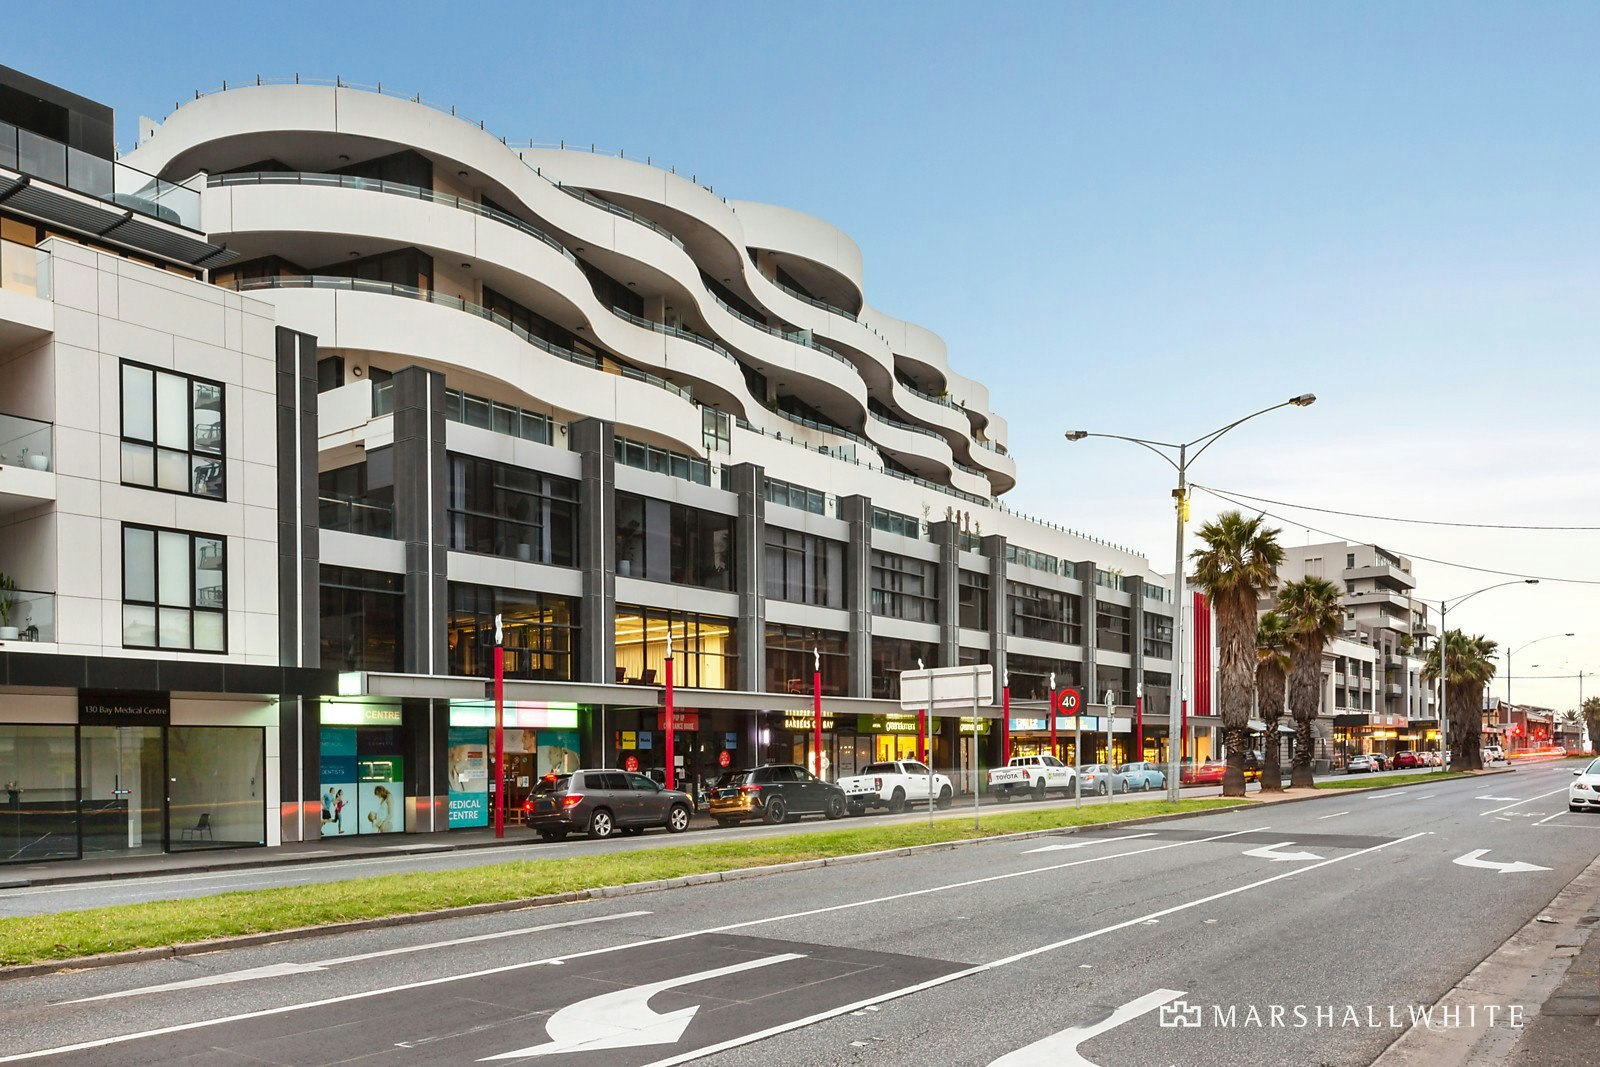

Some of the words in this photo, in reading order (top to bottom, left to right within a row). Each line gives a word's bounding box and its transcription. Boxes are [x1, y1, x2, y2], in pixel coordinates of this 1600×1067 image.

[1062, 696, 1076, 707] 40
[99, 706, 112, 715] Bay
[114, 706, 142, 714] Medical
[365, 710, 400, 720] CENTRE
[785, 719, 811, 729] BARBERS
[822, 720, 834, 729] BAY
[995, 773, 1019, 781] TOYOTA
[449, 810, 479, 821] CENTRE
